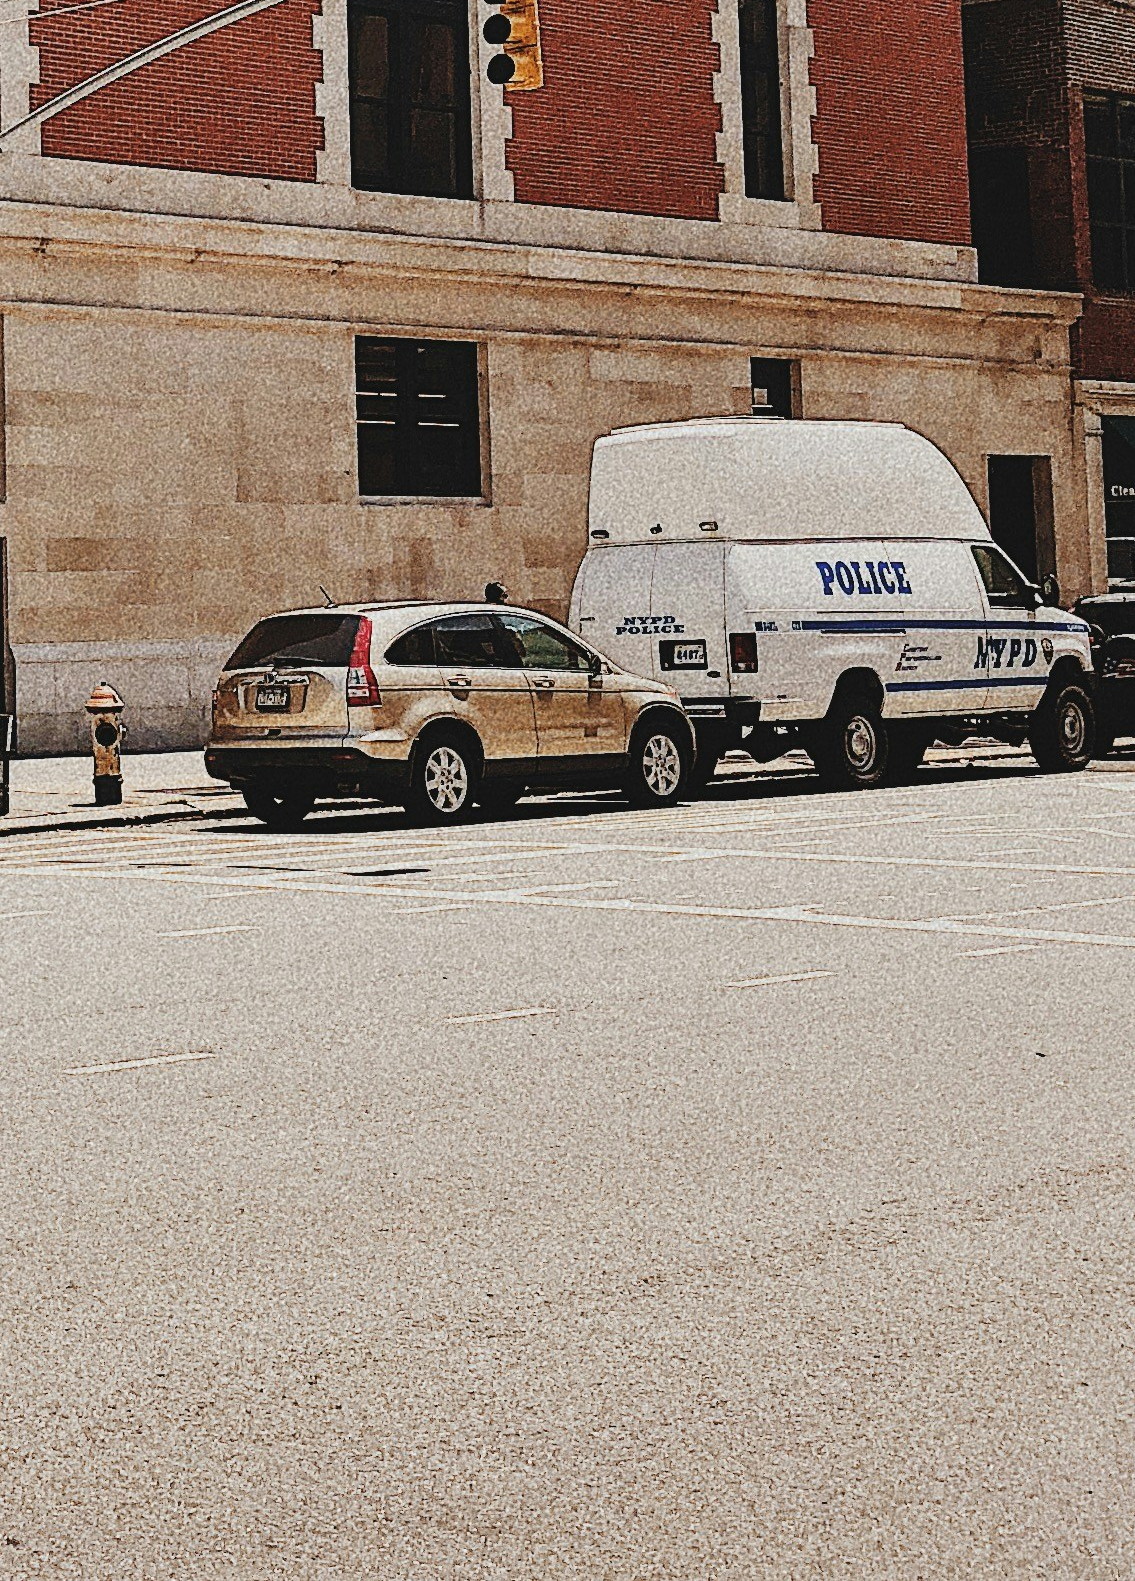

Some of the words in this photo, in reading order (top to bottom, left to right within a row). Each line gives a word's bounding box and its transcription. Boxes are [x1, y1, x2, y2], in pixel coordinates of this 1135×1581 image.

[816, 561, 912, 596] POLICE
[616, 625, 684, 635] POLICE
[624, 616, 675, 625] NYPD
[974, 636, 1038, 669] NYPD
